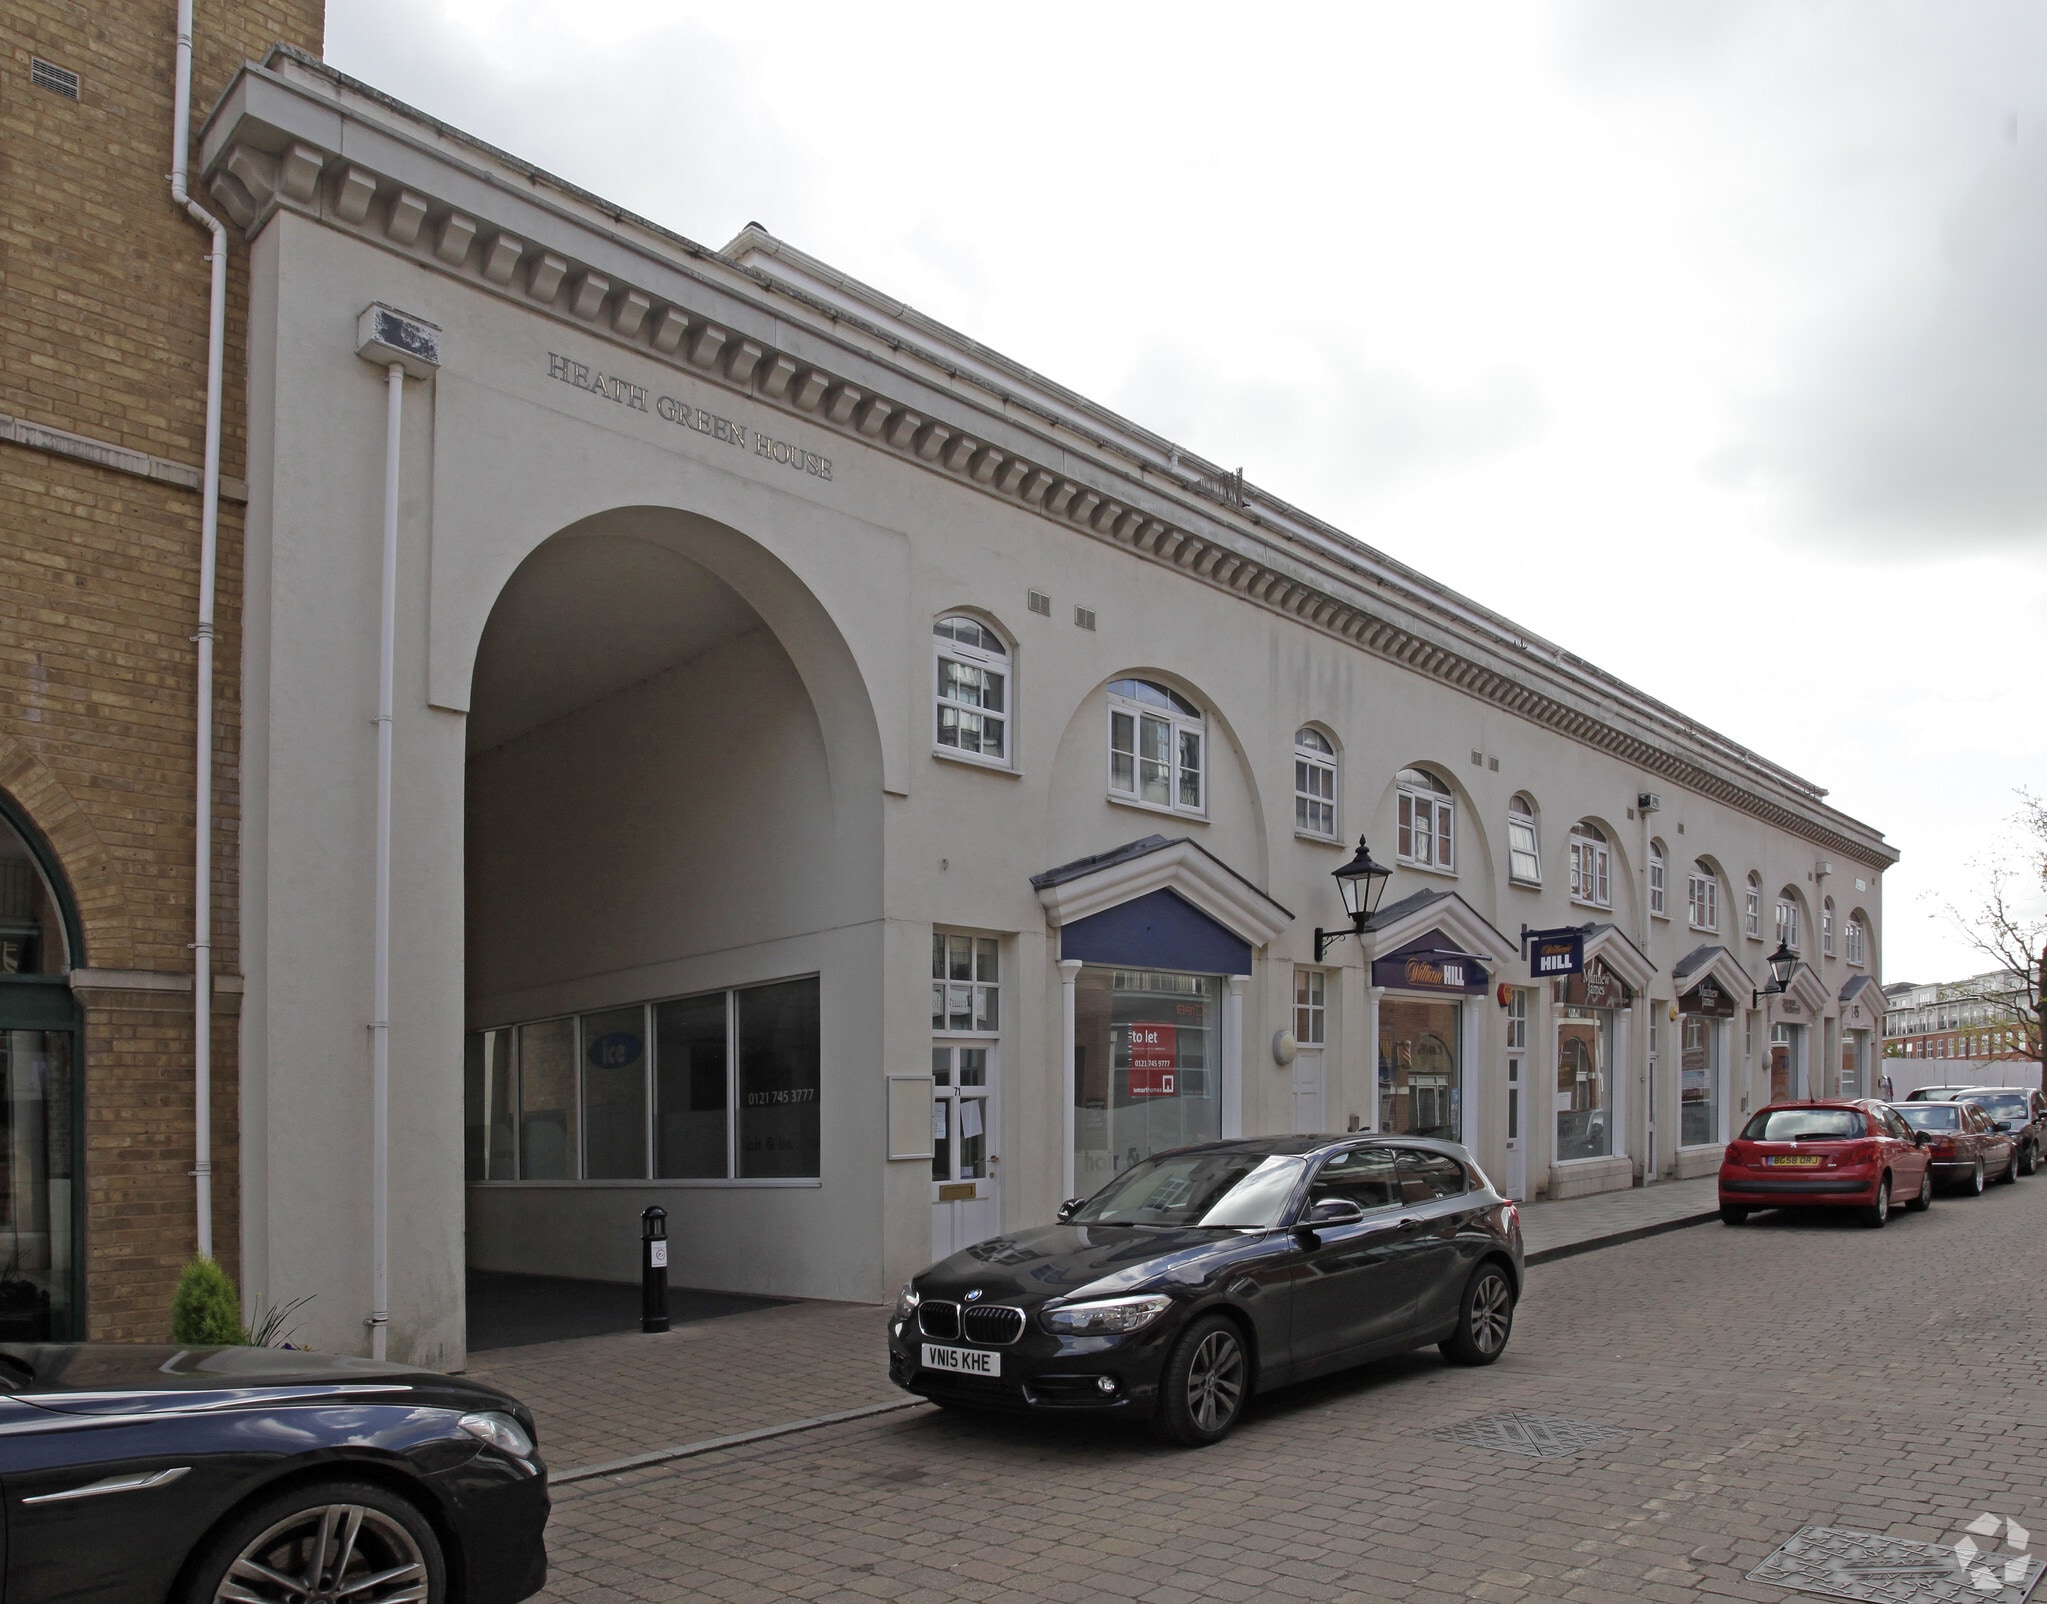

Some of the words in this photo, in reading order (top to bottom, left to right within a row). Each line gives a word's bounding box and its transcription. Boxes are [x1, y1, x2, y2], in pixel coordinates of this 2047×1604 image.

[547, 352, 649, 413] HEATH
[656, 395, 747, 449] GREEN
[754, 432, 833, 482] HOUSE
[1540, 954, 1573, 971] HILL
[1405, 957, 1443, 984] William
[1444, 965, 1465, 986] HILL
[1132, 1030, 1143, 1043] to
[1145, 1029, 1158, 1043] let
[1134, 1059, 1147, 1067] 0121
[1147, 1059, 1157, 1067] 745
[1157, 1059, 1171, 1067] 9777
[748, 1092, 769, 1105] 0121
[772, 1090, 789, 1104] 745
[791, 1088, 814, 1103] 3777
[953, 1087, 961, 1096] 71
[1774, 1156, 1797, 1164] BG58
[929, 1347, 958, 1367] VN15
[962, 1351, 991, 1372] KHE
